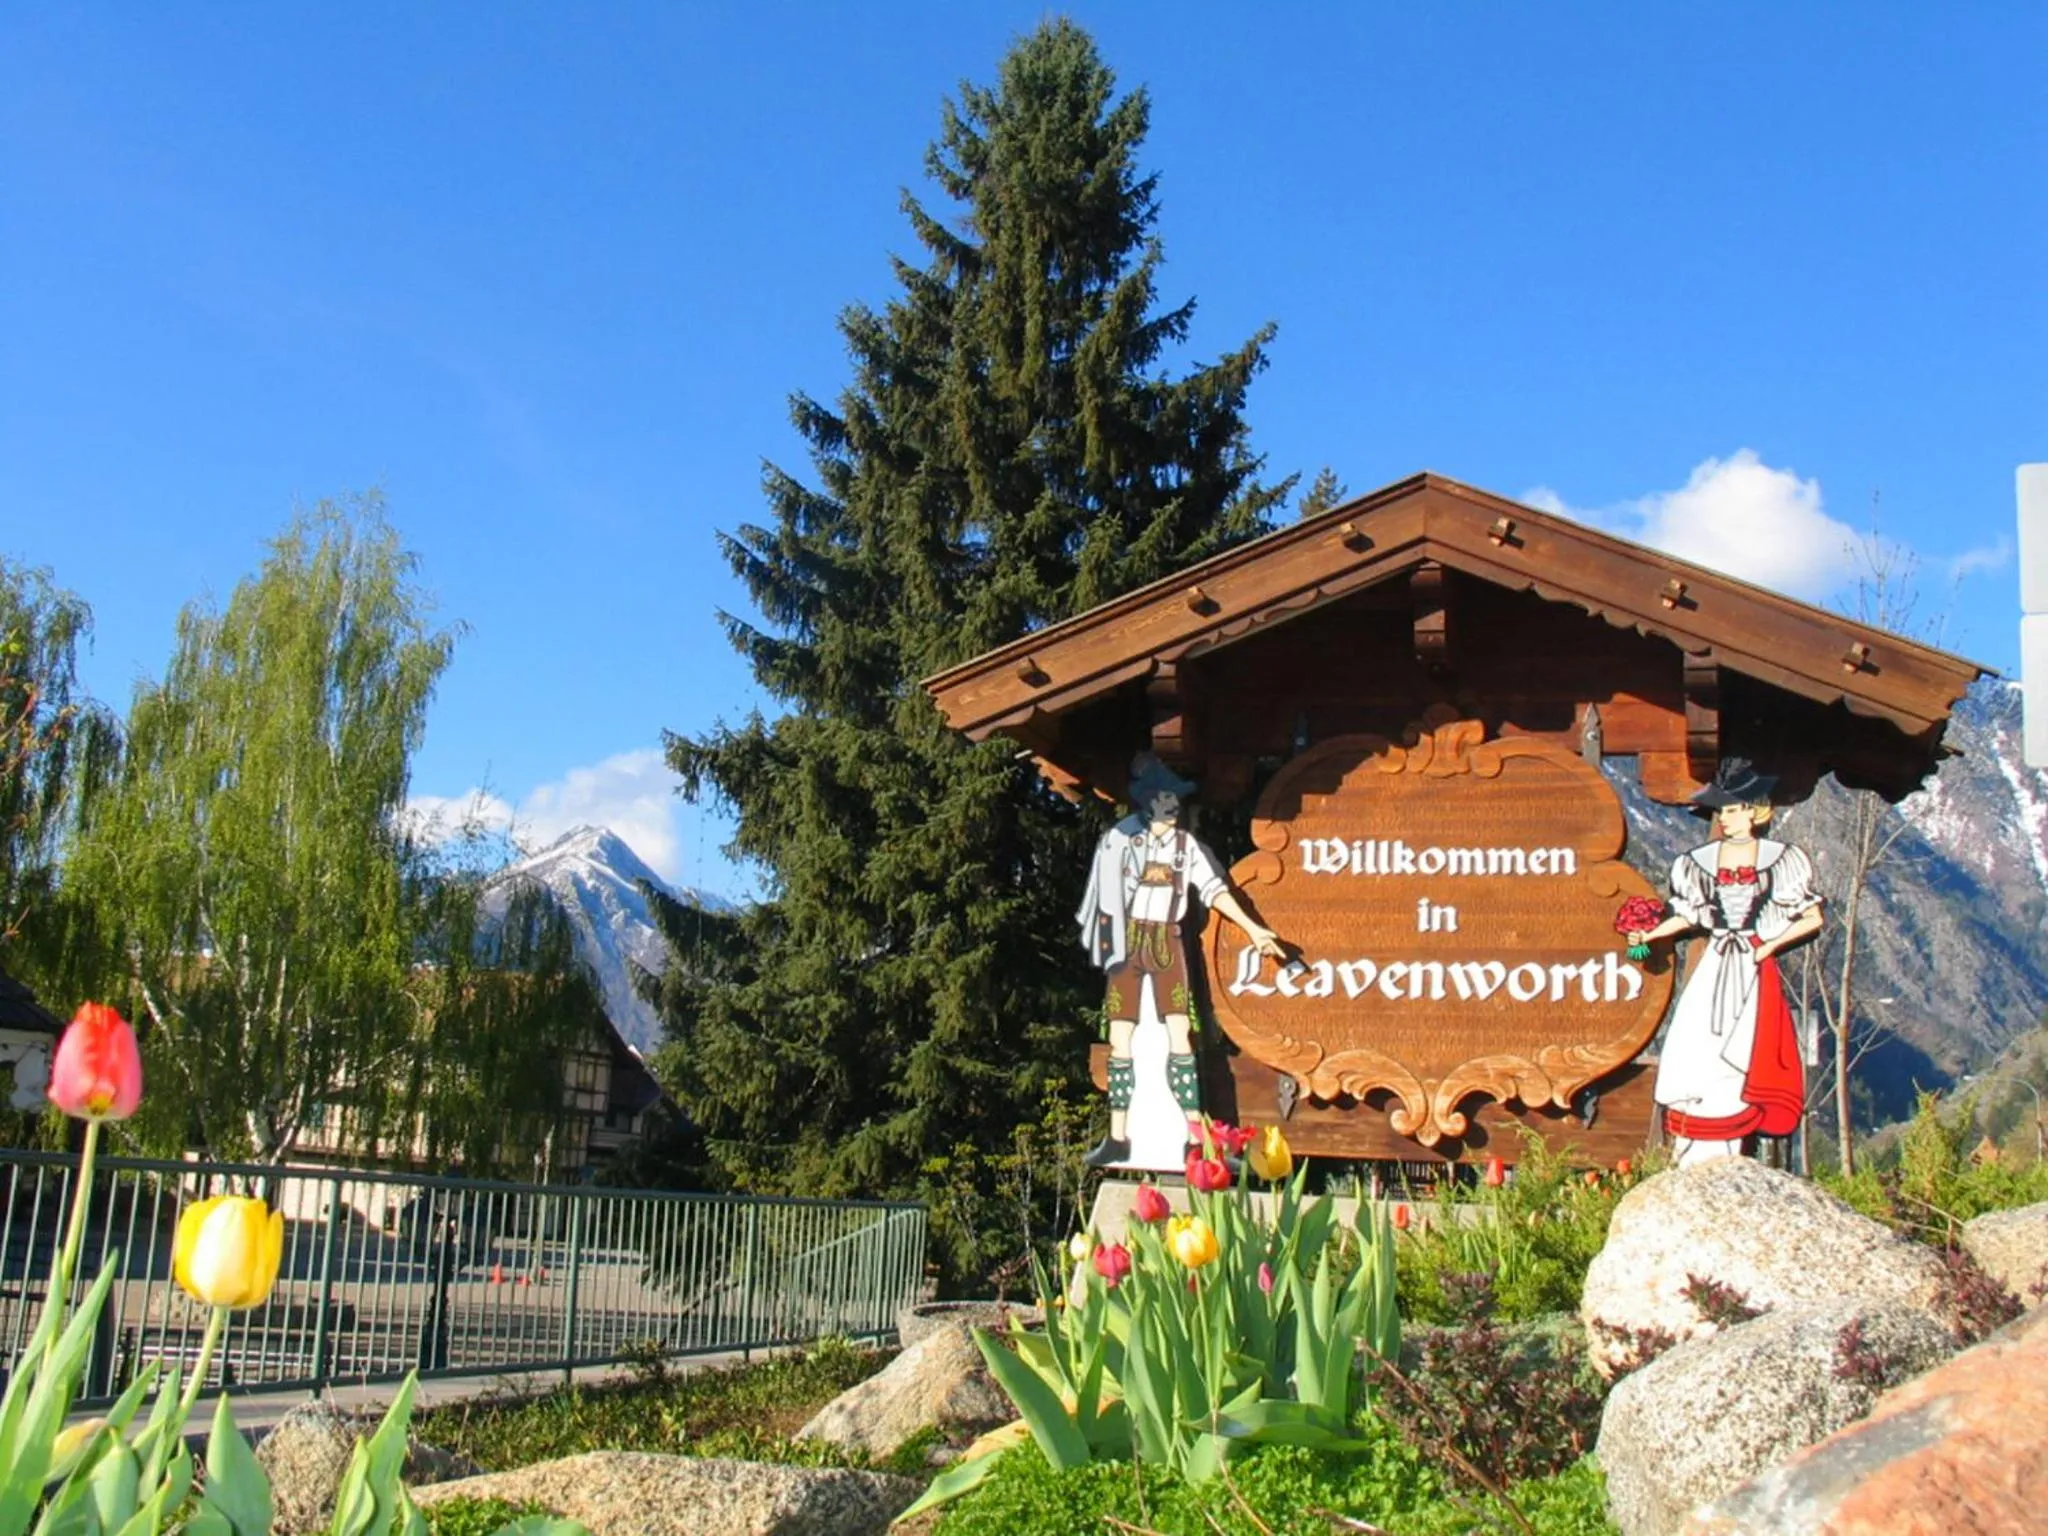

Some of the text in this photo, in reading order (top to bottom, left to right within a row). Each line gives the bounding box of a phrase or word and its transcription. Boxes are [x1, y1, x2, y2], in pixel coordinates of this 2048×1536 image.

[1299, 836, 1577, 876] Willkommen
[1416, 897, 1458, 933] in
[1228, 945, 1644, 1002] Leavenworth
